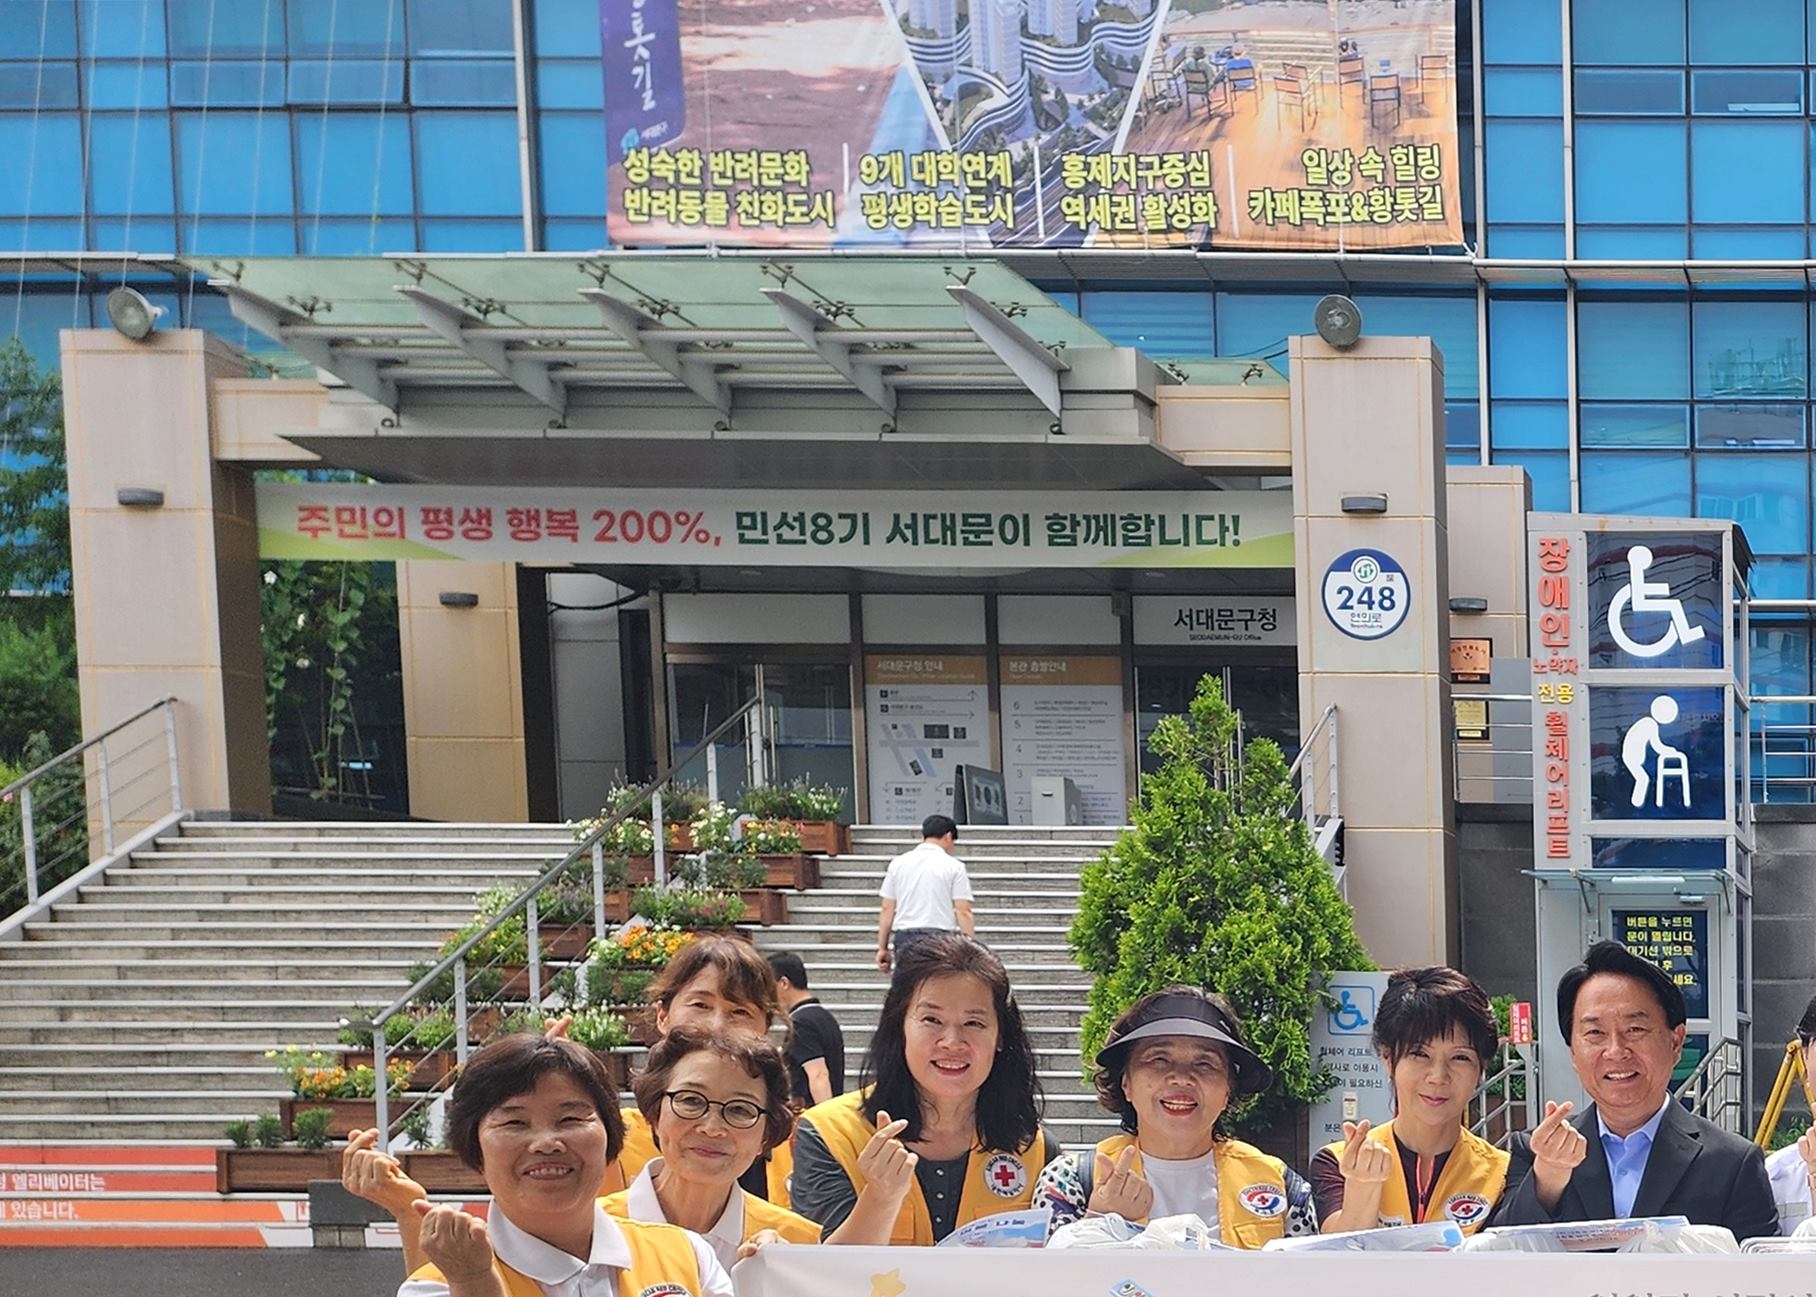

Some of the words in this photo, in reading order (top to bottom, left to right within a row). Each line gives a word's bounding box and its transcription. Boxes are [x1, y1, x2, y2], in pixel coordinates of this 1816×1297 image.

[624, 147, 703, 185] 성숙한
[709, 150, 810, 187] 반려문화
[859, 151, 904, 188] 9개
[910, 151, 1013, 188] 대학연계
[1061, 151, 1212, 190] 홍제지구중심
[1301, 147, 1353, 185] 일상
[1359, 147, 1385, 183] 속
[1390, 144, 1442, 182] 힐링
[623, 187, 729, 224] 반려동물
[735, 190, 836, 228] 친화도시
[861, 193, 1015, 229] 평생학습도시
[1060, 193, 1137, 230] 역세권
[1141, 193, 1220, 231] 활성화
[1248, 184, 1445, 226] 카페폭포&황톳길
[297, 505, 405, 540] 주민의
[420, 506, 493, 541] 평생
[506, 507, 579, 543] 행복
[592, 509, 721, 547] 200%,
[735, 511, 871, 546] 민선8기
[886, 511, 1031, 547] 서대문이
[1045, 513, 1240, 548] 함께합니다!
[1336, 585, 1396, 612] 248
[1538, 537, 1571, 648] 장애인
[1174, 607, 1277, 632] 서대문구청
[1533, 657, 1578, 676] 노약자
[1538, 682, 1574, 704] 전용
[1545, 711, 1571, 858] 휠체어리프트
[1626, 916, 1658, 928] 버튼을
[1661, 916, 1693, 928] 누르면
[1627, 931, 1648, 942] 문이
[12, 1172, 105, 1191] 엘리베이터는
[11, 1200, 79, 1220] 있습니다.
